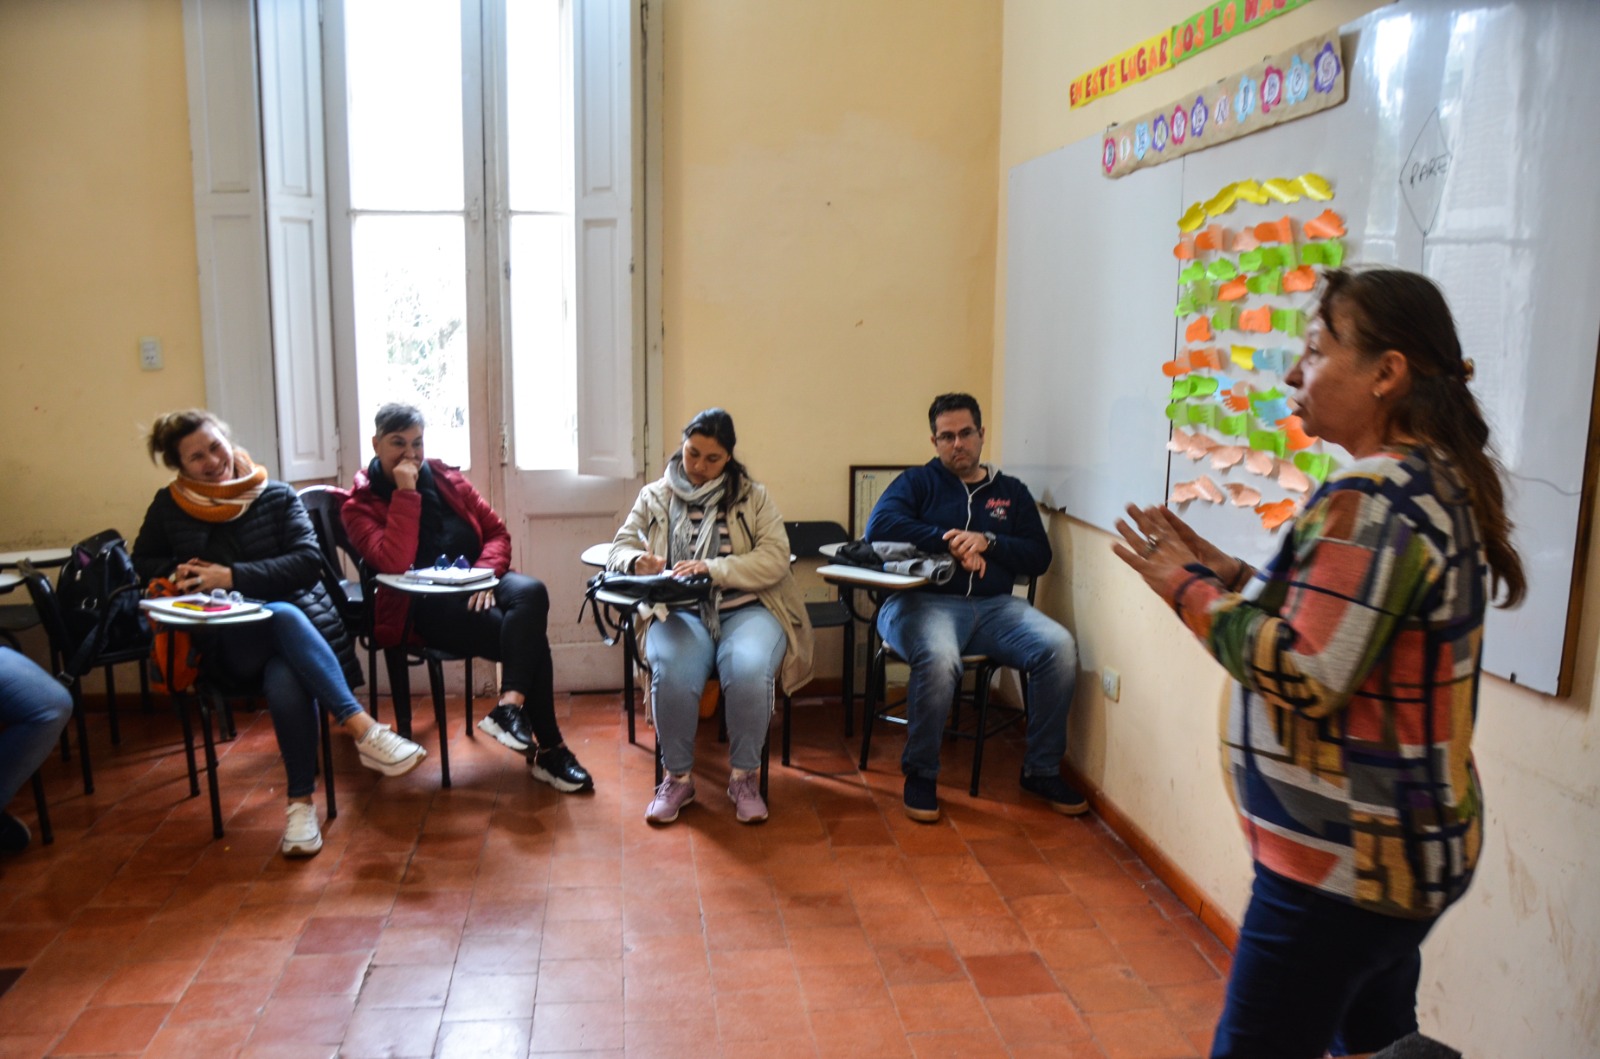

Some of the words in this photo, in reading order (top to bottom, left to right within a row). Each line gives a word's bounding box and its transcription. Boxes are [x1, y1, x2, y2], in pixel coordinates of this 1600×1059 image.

[1070, 80, 1082, 107] EN
[1086, 63, 1116, 98] ESTE
[1121, 36, 1168, 83] LUGAR
[1173, 14, 1206, 58] SOS
[1212, 1, 1237, 38] LO
[1104, 46, 1338, 170] BIENVENIDOS
[1410, 154, 1448, 188] PARE
